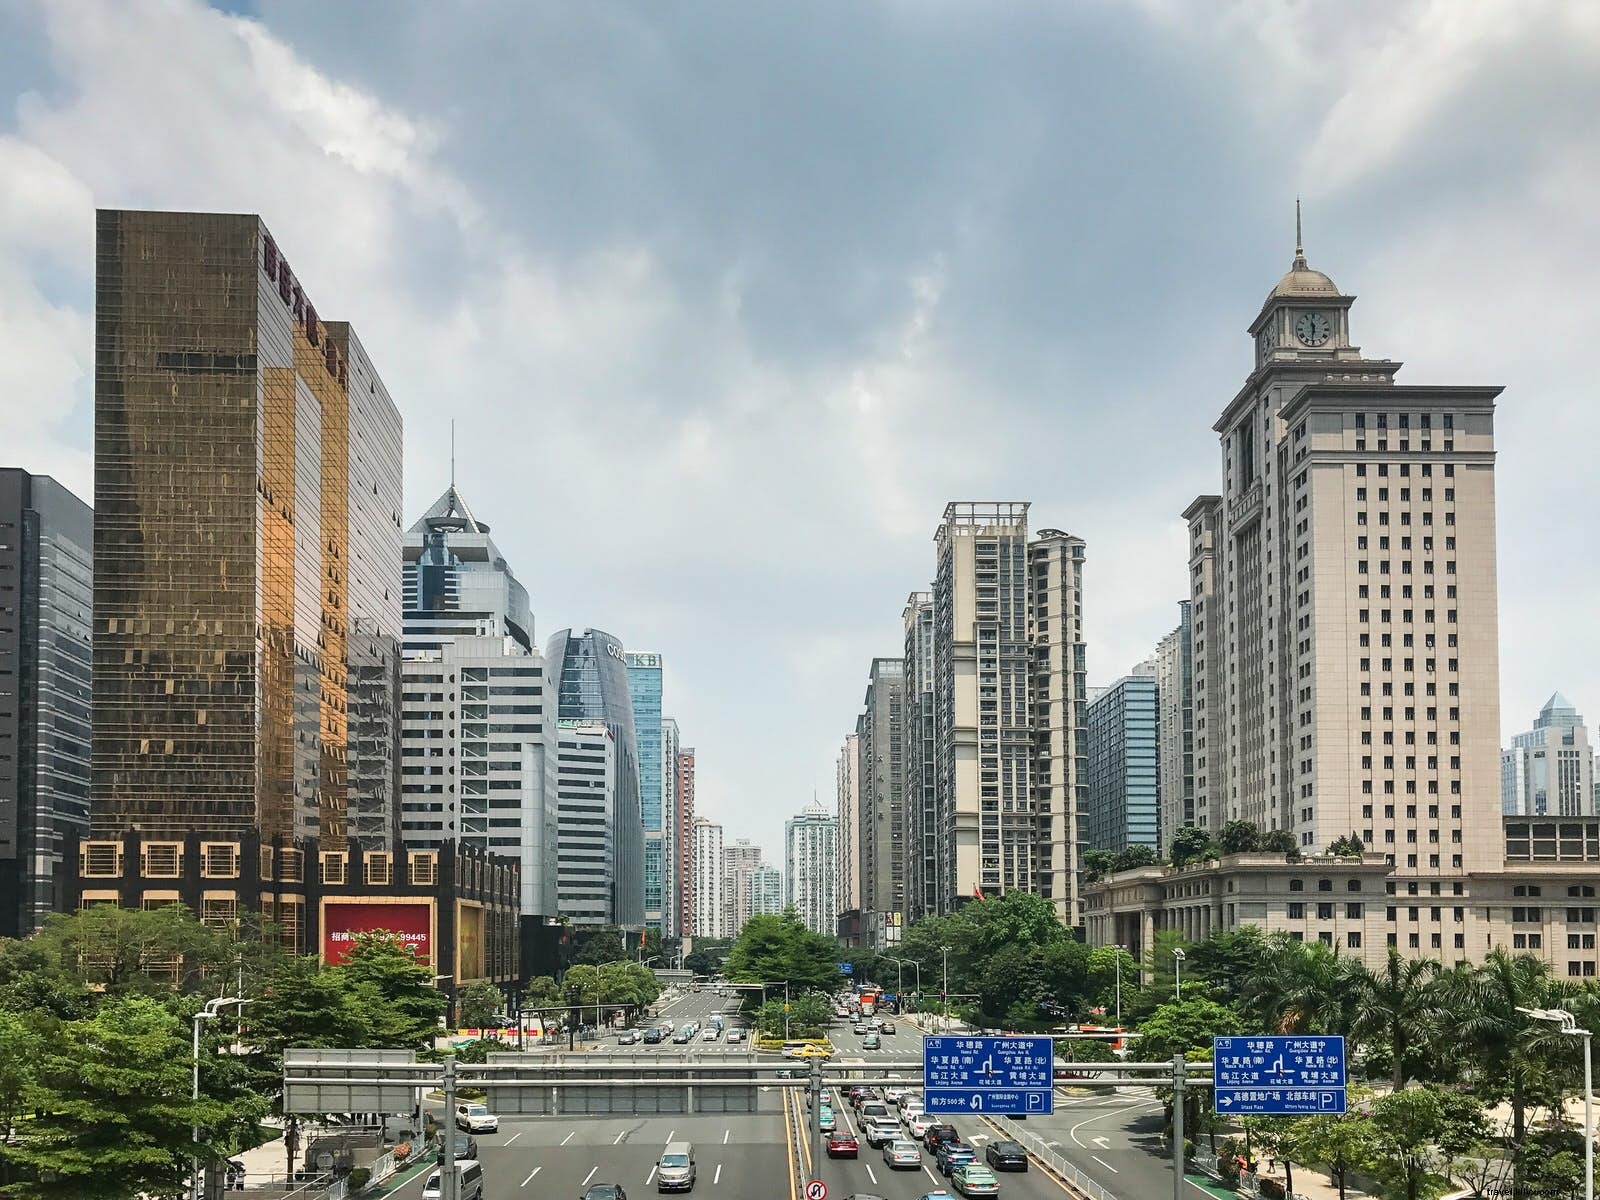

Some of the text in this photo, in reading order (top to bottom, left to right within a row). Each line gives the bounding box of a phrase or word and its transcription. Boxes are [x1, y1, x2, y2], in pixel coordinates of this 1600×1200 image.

[994, 1041, 1033, 1049] 广州大道中
[1285, 1041, 1326, 1049] 广州大道中
[1009, 1072, 1046, 1080] 黄埔大道
[1221, 1072, 1259, 1080] 临江大道
[1301, 1071, 1338, 1079] 黄埔大道
[931, 1097, 966, 1106] 前方500米
